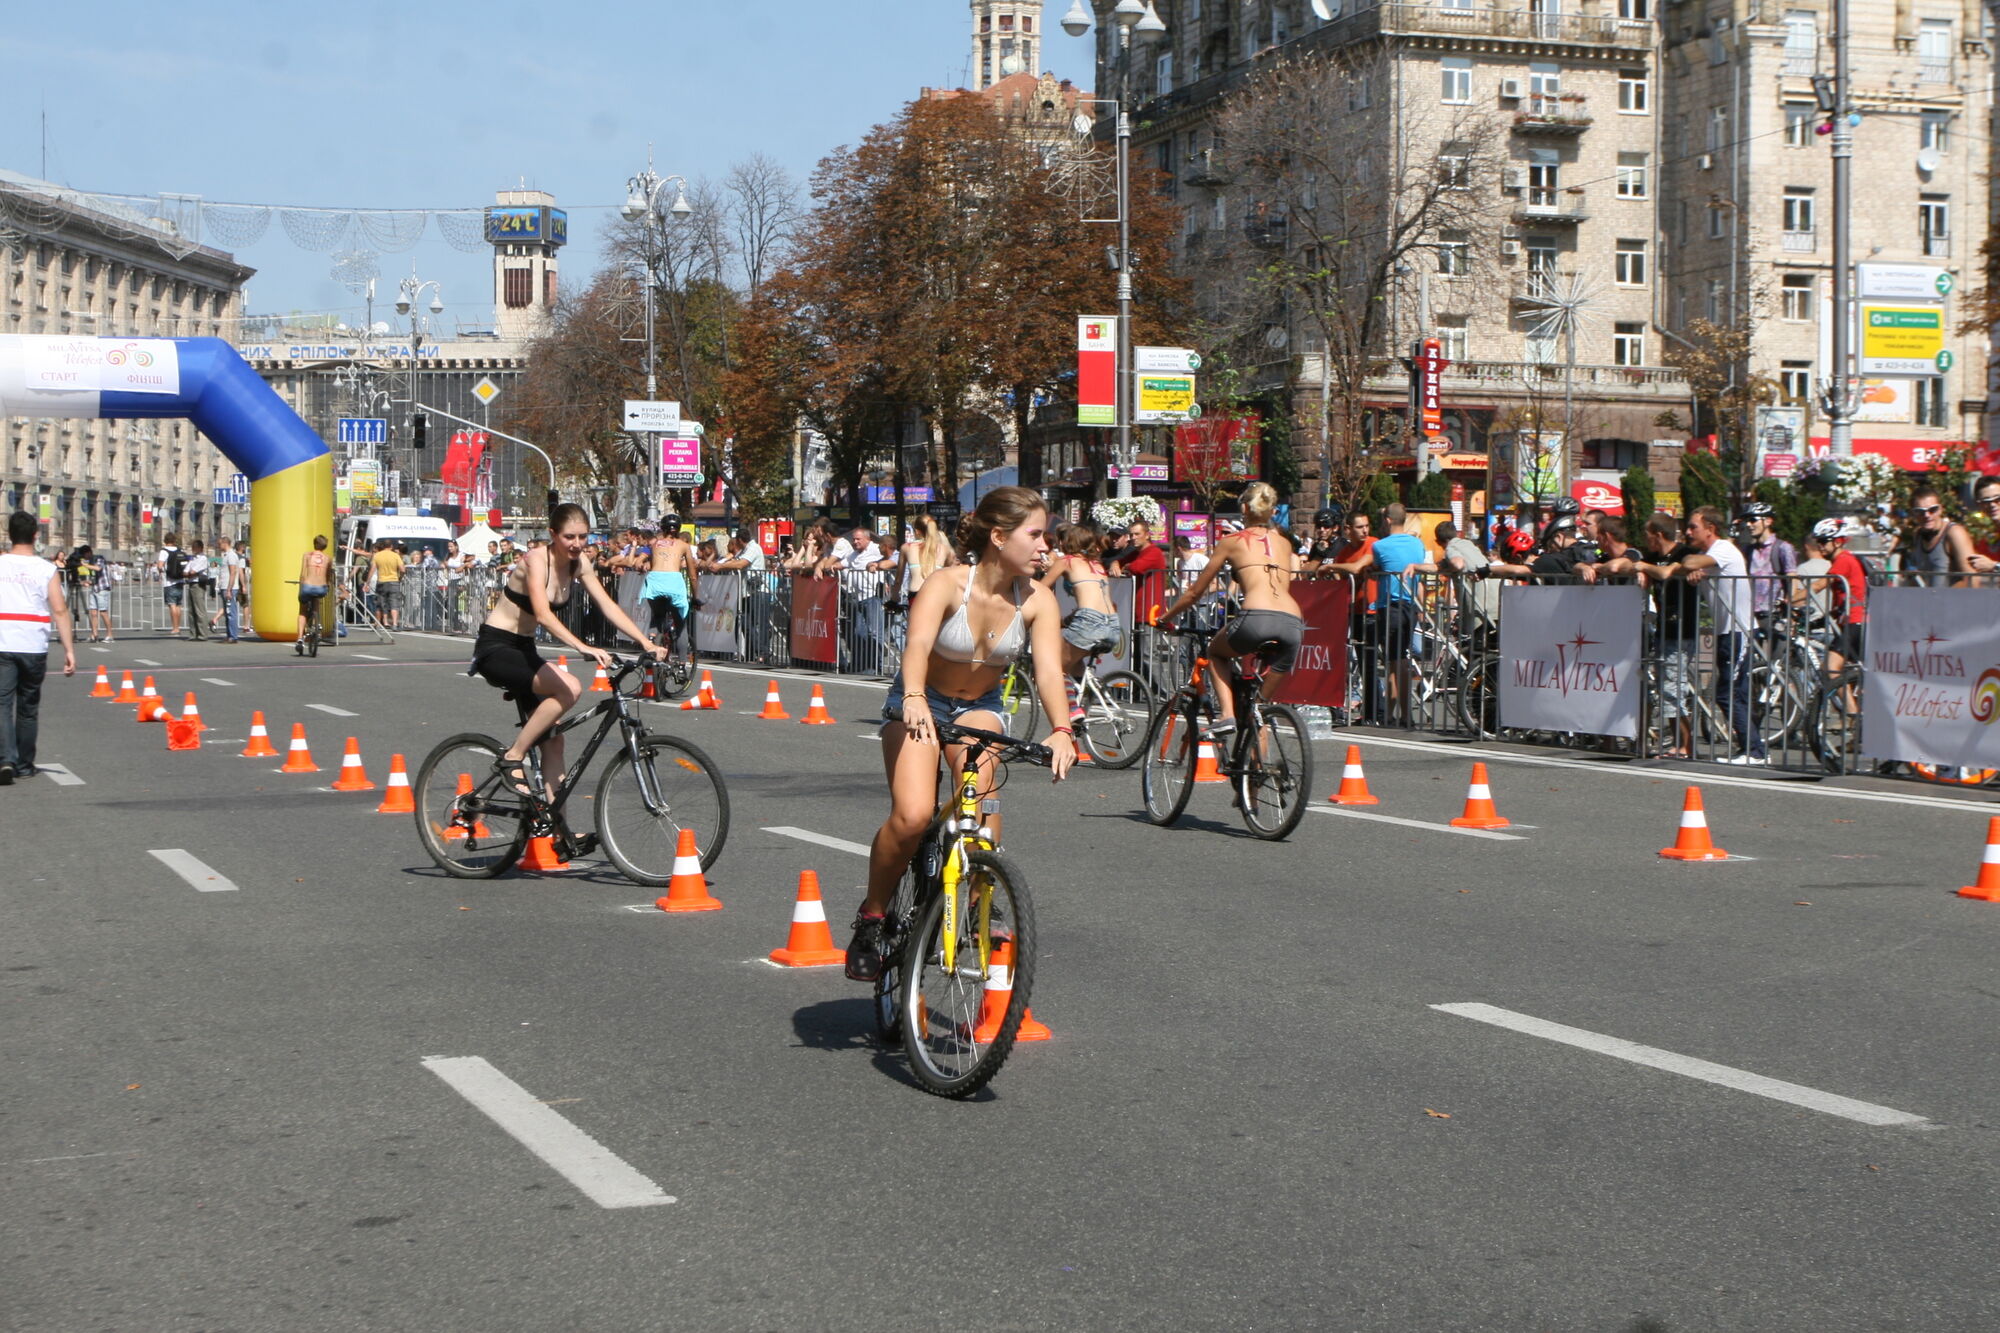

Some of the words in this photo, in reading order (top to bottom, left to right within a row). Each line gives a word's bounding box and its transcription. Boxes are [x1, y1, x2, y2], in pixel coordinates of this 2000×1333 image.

[290, 346, 350, 359] СПІЛОК
[367, 345, 440, 358] УРАНИ
[41, 372, 78, 382] СТАРТ
[1513, 643, 1618, 699] MILAVITSA
[1874, 640, 1966, 681] MILAVITSA
[1895, 683, 1964, 728] Velofest
